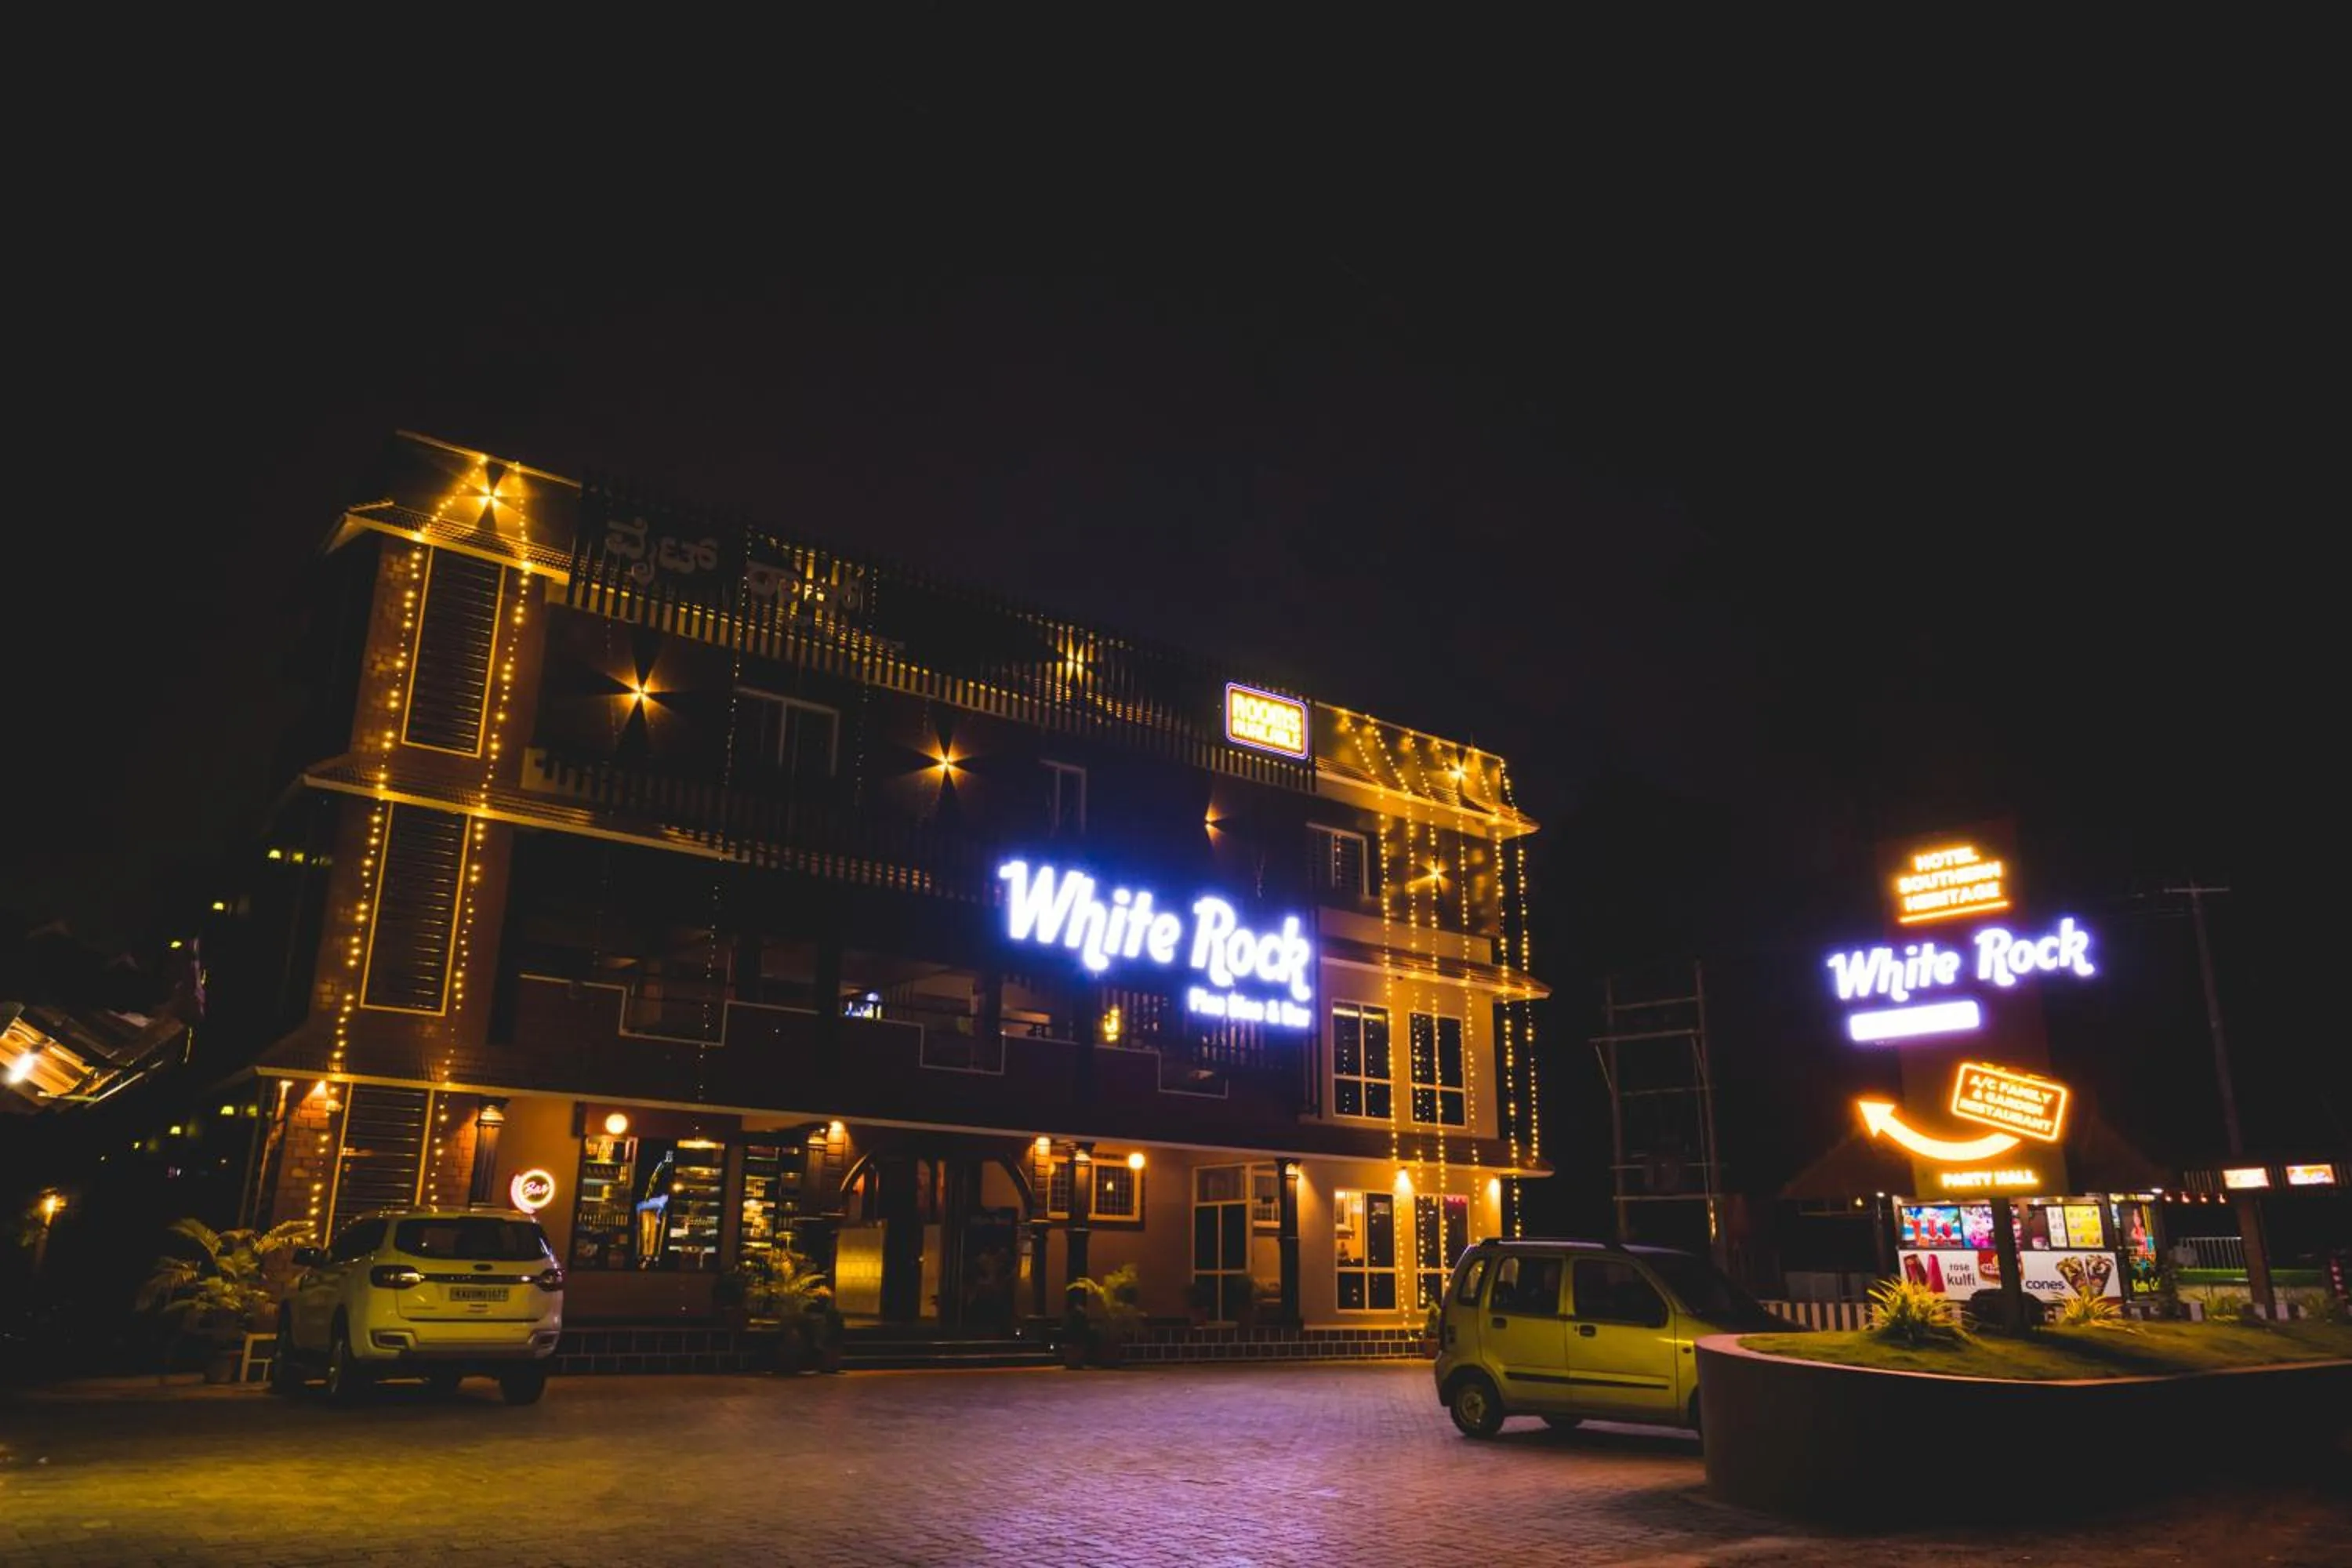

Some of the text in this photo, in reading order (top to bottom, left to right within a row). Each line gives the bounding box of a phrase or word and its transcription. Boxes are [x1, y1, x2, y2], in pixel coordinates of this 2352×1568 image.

[1232, 693, 1301, 732] ROOMS
[1915, 846, 1980, 872] HOTEL
[1897, 861, 2002, 895] SOUTHERN
[1904, 881, 2001, 911] HERITAGE
[999, 860, 1312, 1002] White Rock
[1828, 917, 2096, 1002] White Rock
[1969, 1074, 2053, 1105] A/C FAMILY
[1984, 1091, 2045, 1116] GARDEN
[1958, 1098, 2053, 1131] RESTAURANT
[1994, 1170, 2038, 1186] HALL
[1947, 1273, 1976, 1287] kulfi
[1949, 1263, 1970, 1272] rose
[2025, 1279, 2066, 1290] cones
